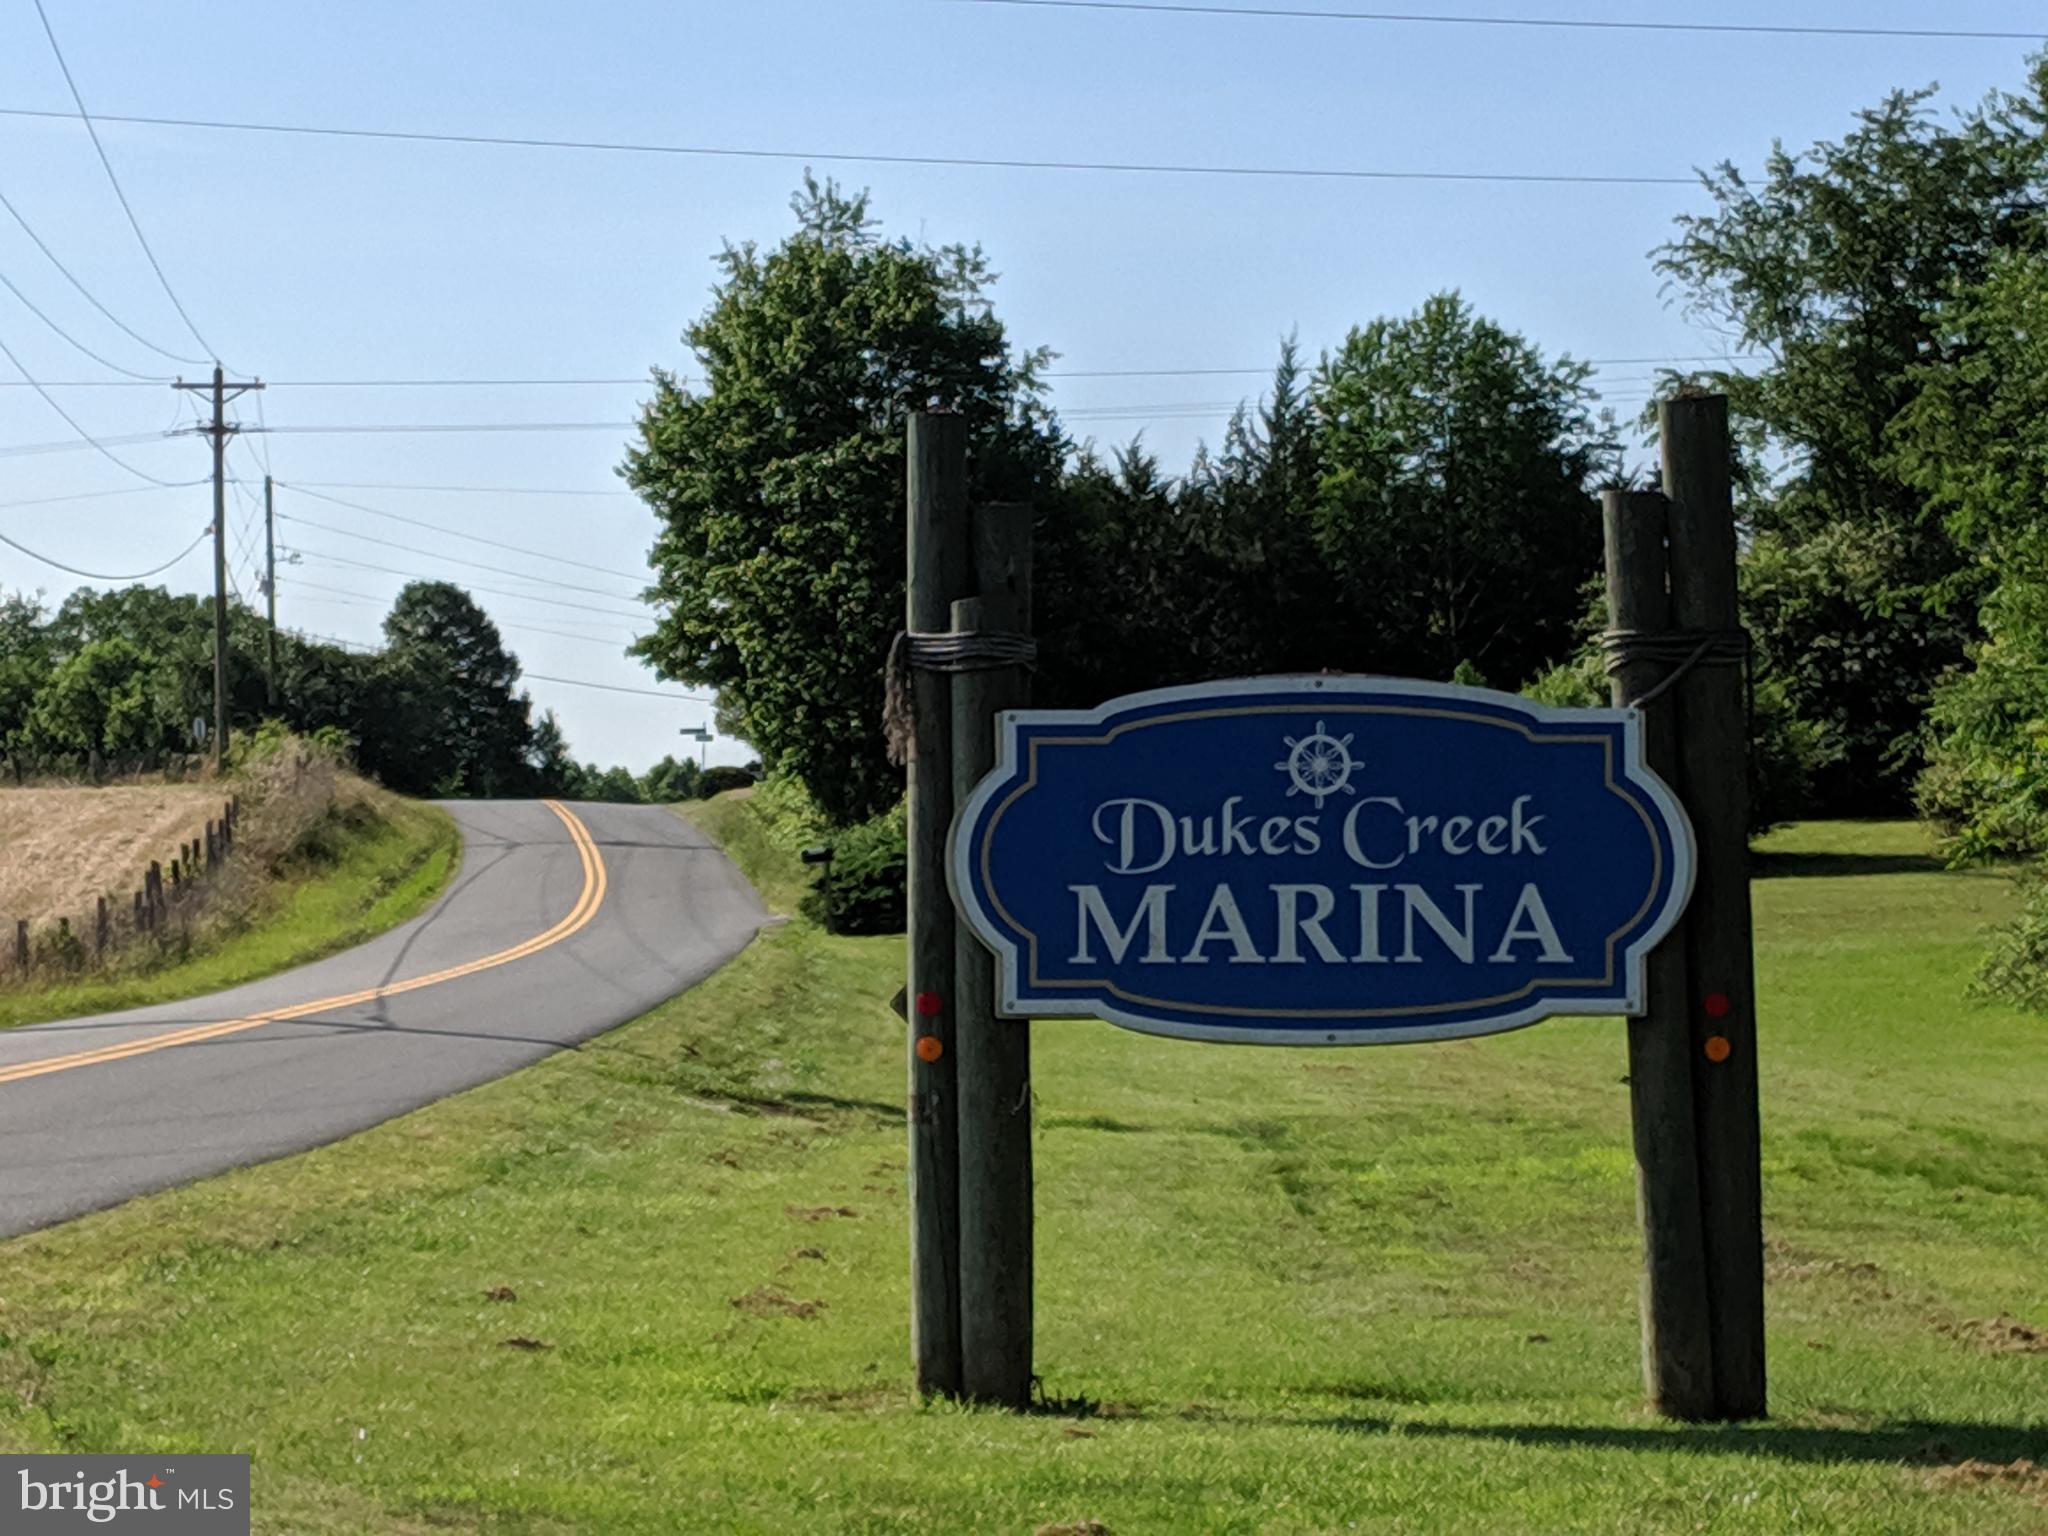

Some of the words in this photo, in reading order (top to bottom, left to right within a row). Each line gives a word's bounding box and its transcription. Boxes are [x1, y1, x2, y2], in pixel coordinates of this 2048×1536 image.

[1092, 796, 1321, 874] Dukes
[1342, 794, 1547, 869] Creek
[1067, 882, 1574, 965] MARINA
